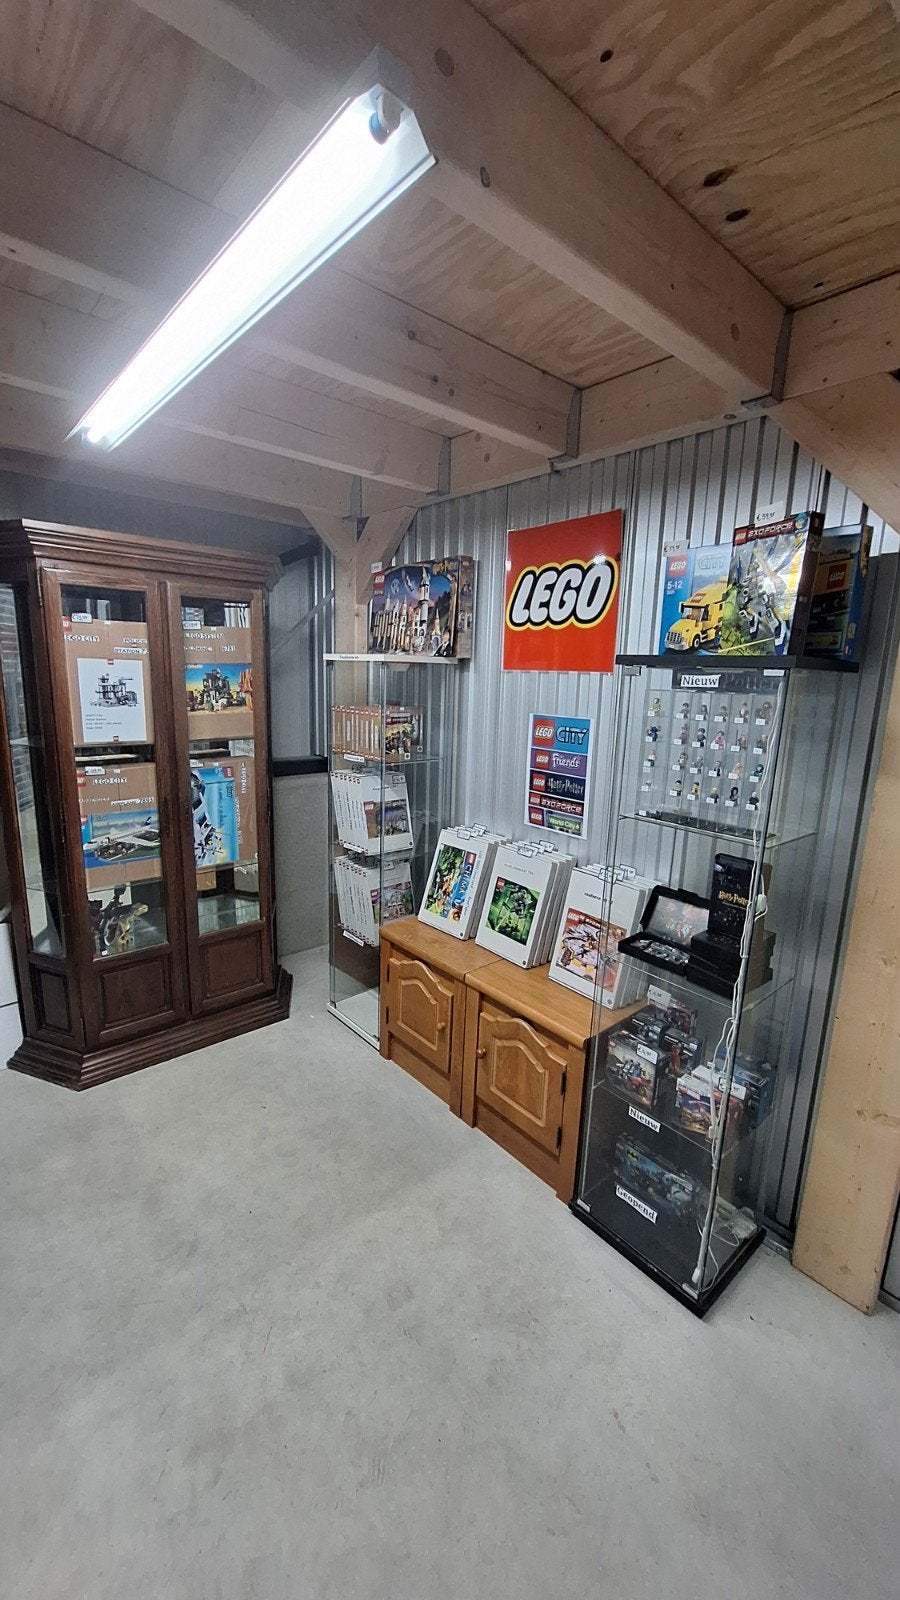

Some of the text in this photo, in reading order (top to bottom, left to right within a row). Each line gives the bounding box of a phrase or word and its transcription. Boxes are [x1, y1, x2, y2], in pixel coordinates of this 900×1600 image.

[669, 561, 687, 571] LEGO
[508, 557, 616, 628] LEGO
[667, 581, 683, 590] 5-12
[64, 634, 83, 642] EGO
[682, 676, 719, 686] Nieuw
[535, 726, 589, 746] LEGO CITY
[536, 753, 580, 768] LEGO Friends
[533, 778, 546, 787] LEGO
[531, 813, 575, 830] LEGO World City
[459, 864, 473, 895] CHIMA
[629, 1108, 659, 1131] Nieuw
[617, 1187, 655, 1220] Geopend
